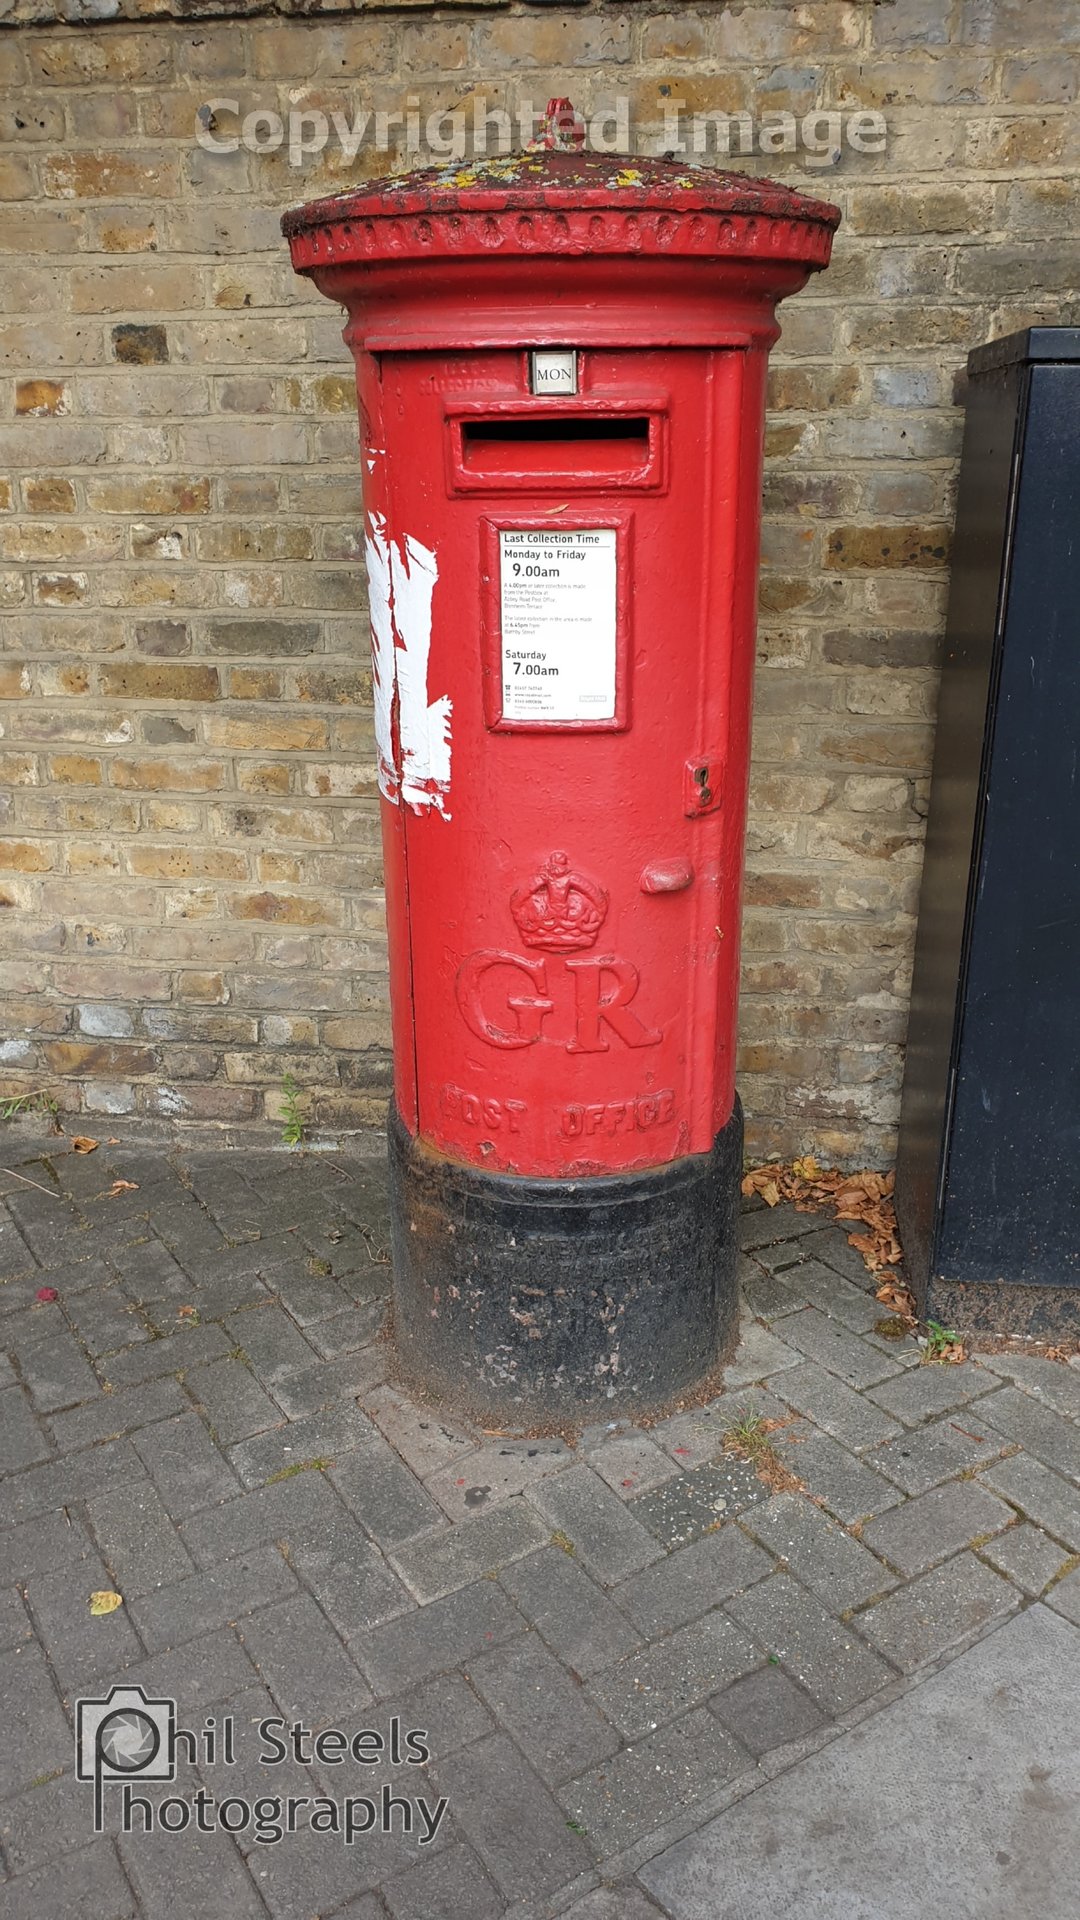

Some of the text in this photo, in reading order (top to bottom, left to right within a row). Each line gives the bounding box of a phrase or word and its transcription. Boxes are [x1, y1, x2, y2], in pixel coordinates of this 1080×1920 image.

[537, 368, 572, 381] MON
[504, 533, 600, 543] Last Collection Time
[504, 550, 586, 561] Monday to Friday
[512, 562, 560, 577] 9.00am
[505, 650, 547, 661] Saturday
[513, 662, 559, 676] 7.00am
[445, 1083, 676, 1137] POST OFFICE
